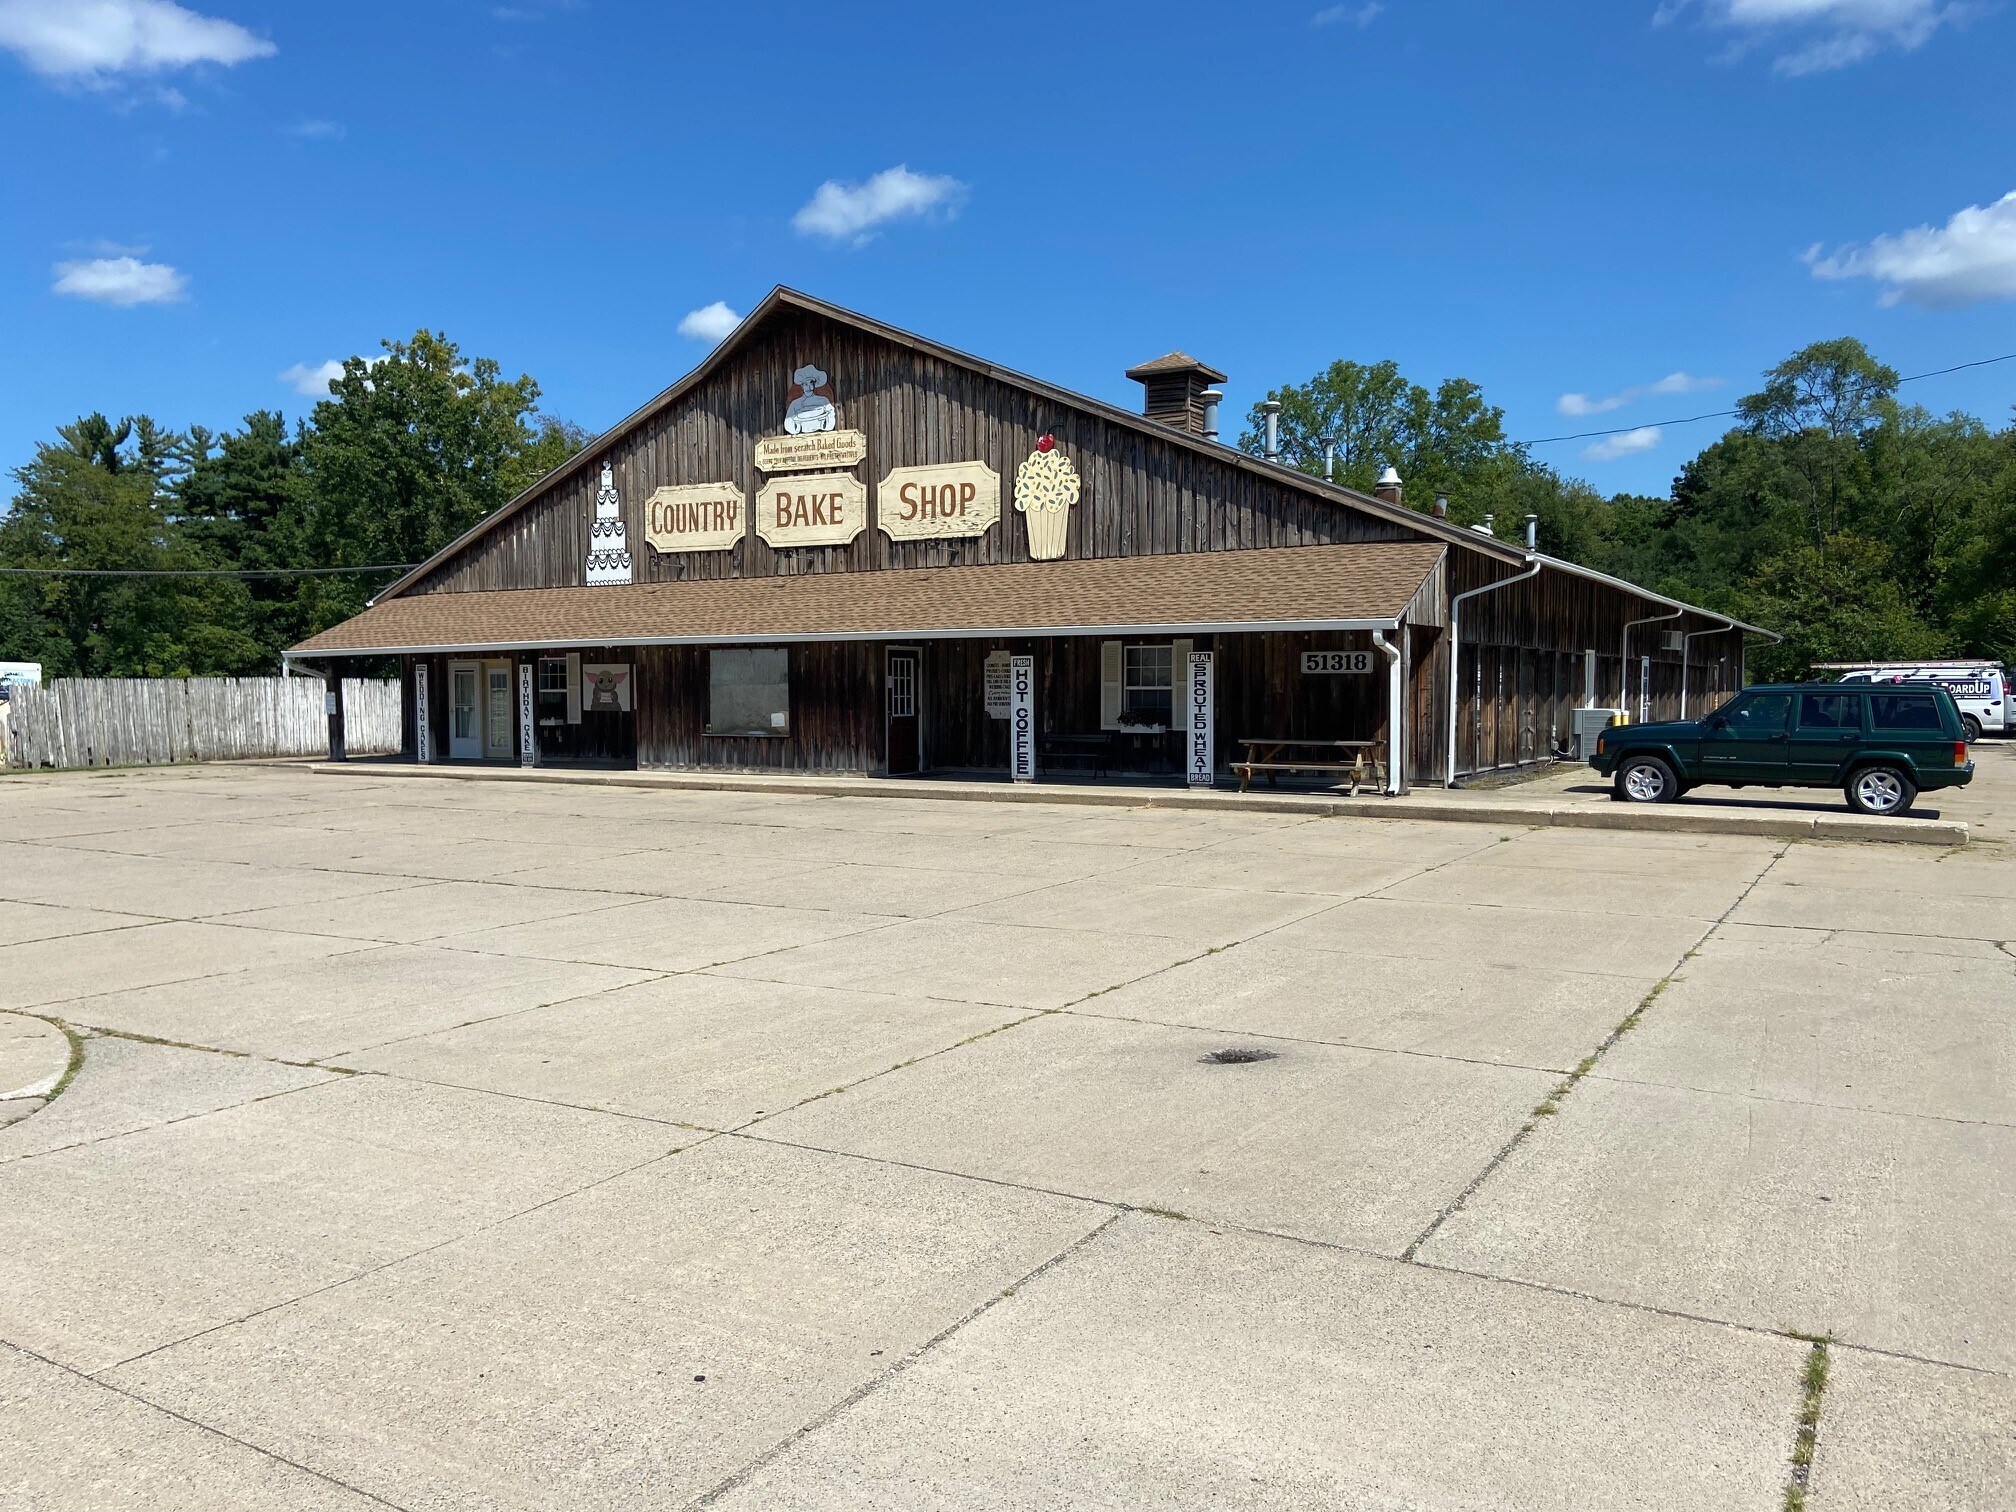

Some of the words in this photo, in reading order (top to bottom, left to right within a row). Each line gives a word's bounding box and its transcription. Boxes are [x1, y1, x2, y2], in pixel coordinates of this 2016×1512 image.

[763, 443, 779, 455] Made
[780, 442, 793, 454] from
[794, 440, 815, 452] scratch
[817, 438, 835, 451] Baked
[836, 436, 857, 449] Goods
[651, 500, 738, 535] COUNTRY
[776, 492, 844, 528] BAKE
[899, 482, 976, 521] SHOP
[1013, 658, 1030, 667] FRESH
[1190, 654, 1210, 662] REAL
[1306, 653, 1367, 671] 51318
[418, 672, 426, 722] WEDDING
[522, 666, 530, 720] BIRTHDAY
[1016, 669, 1029, 703] HOT
[1194, 663, 1207, 730] SPROUTED
[1016, 708, 1029, 775] COFFEE
[1194, 732, 1207, 773] WHEAT
[1190, 773, 1210, 782] BREAD
